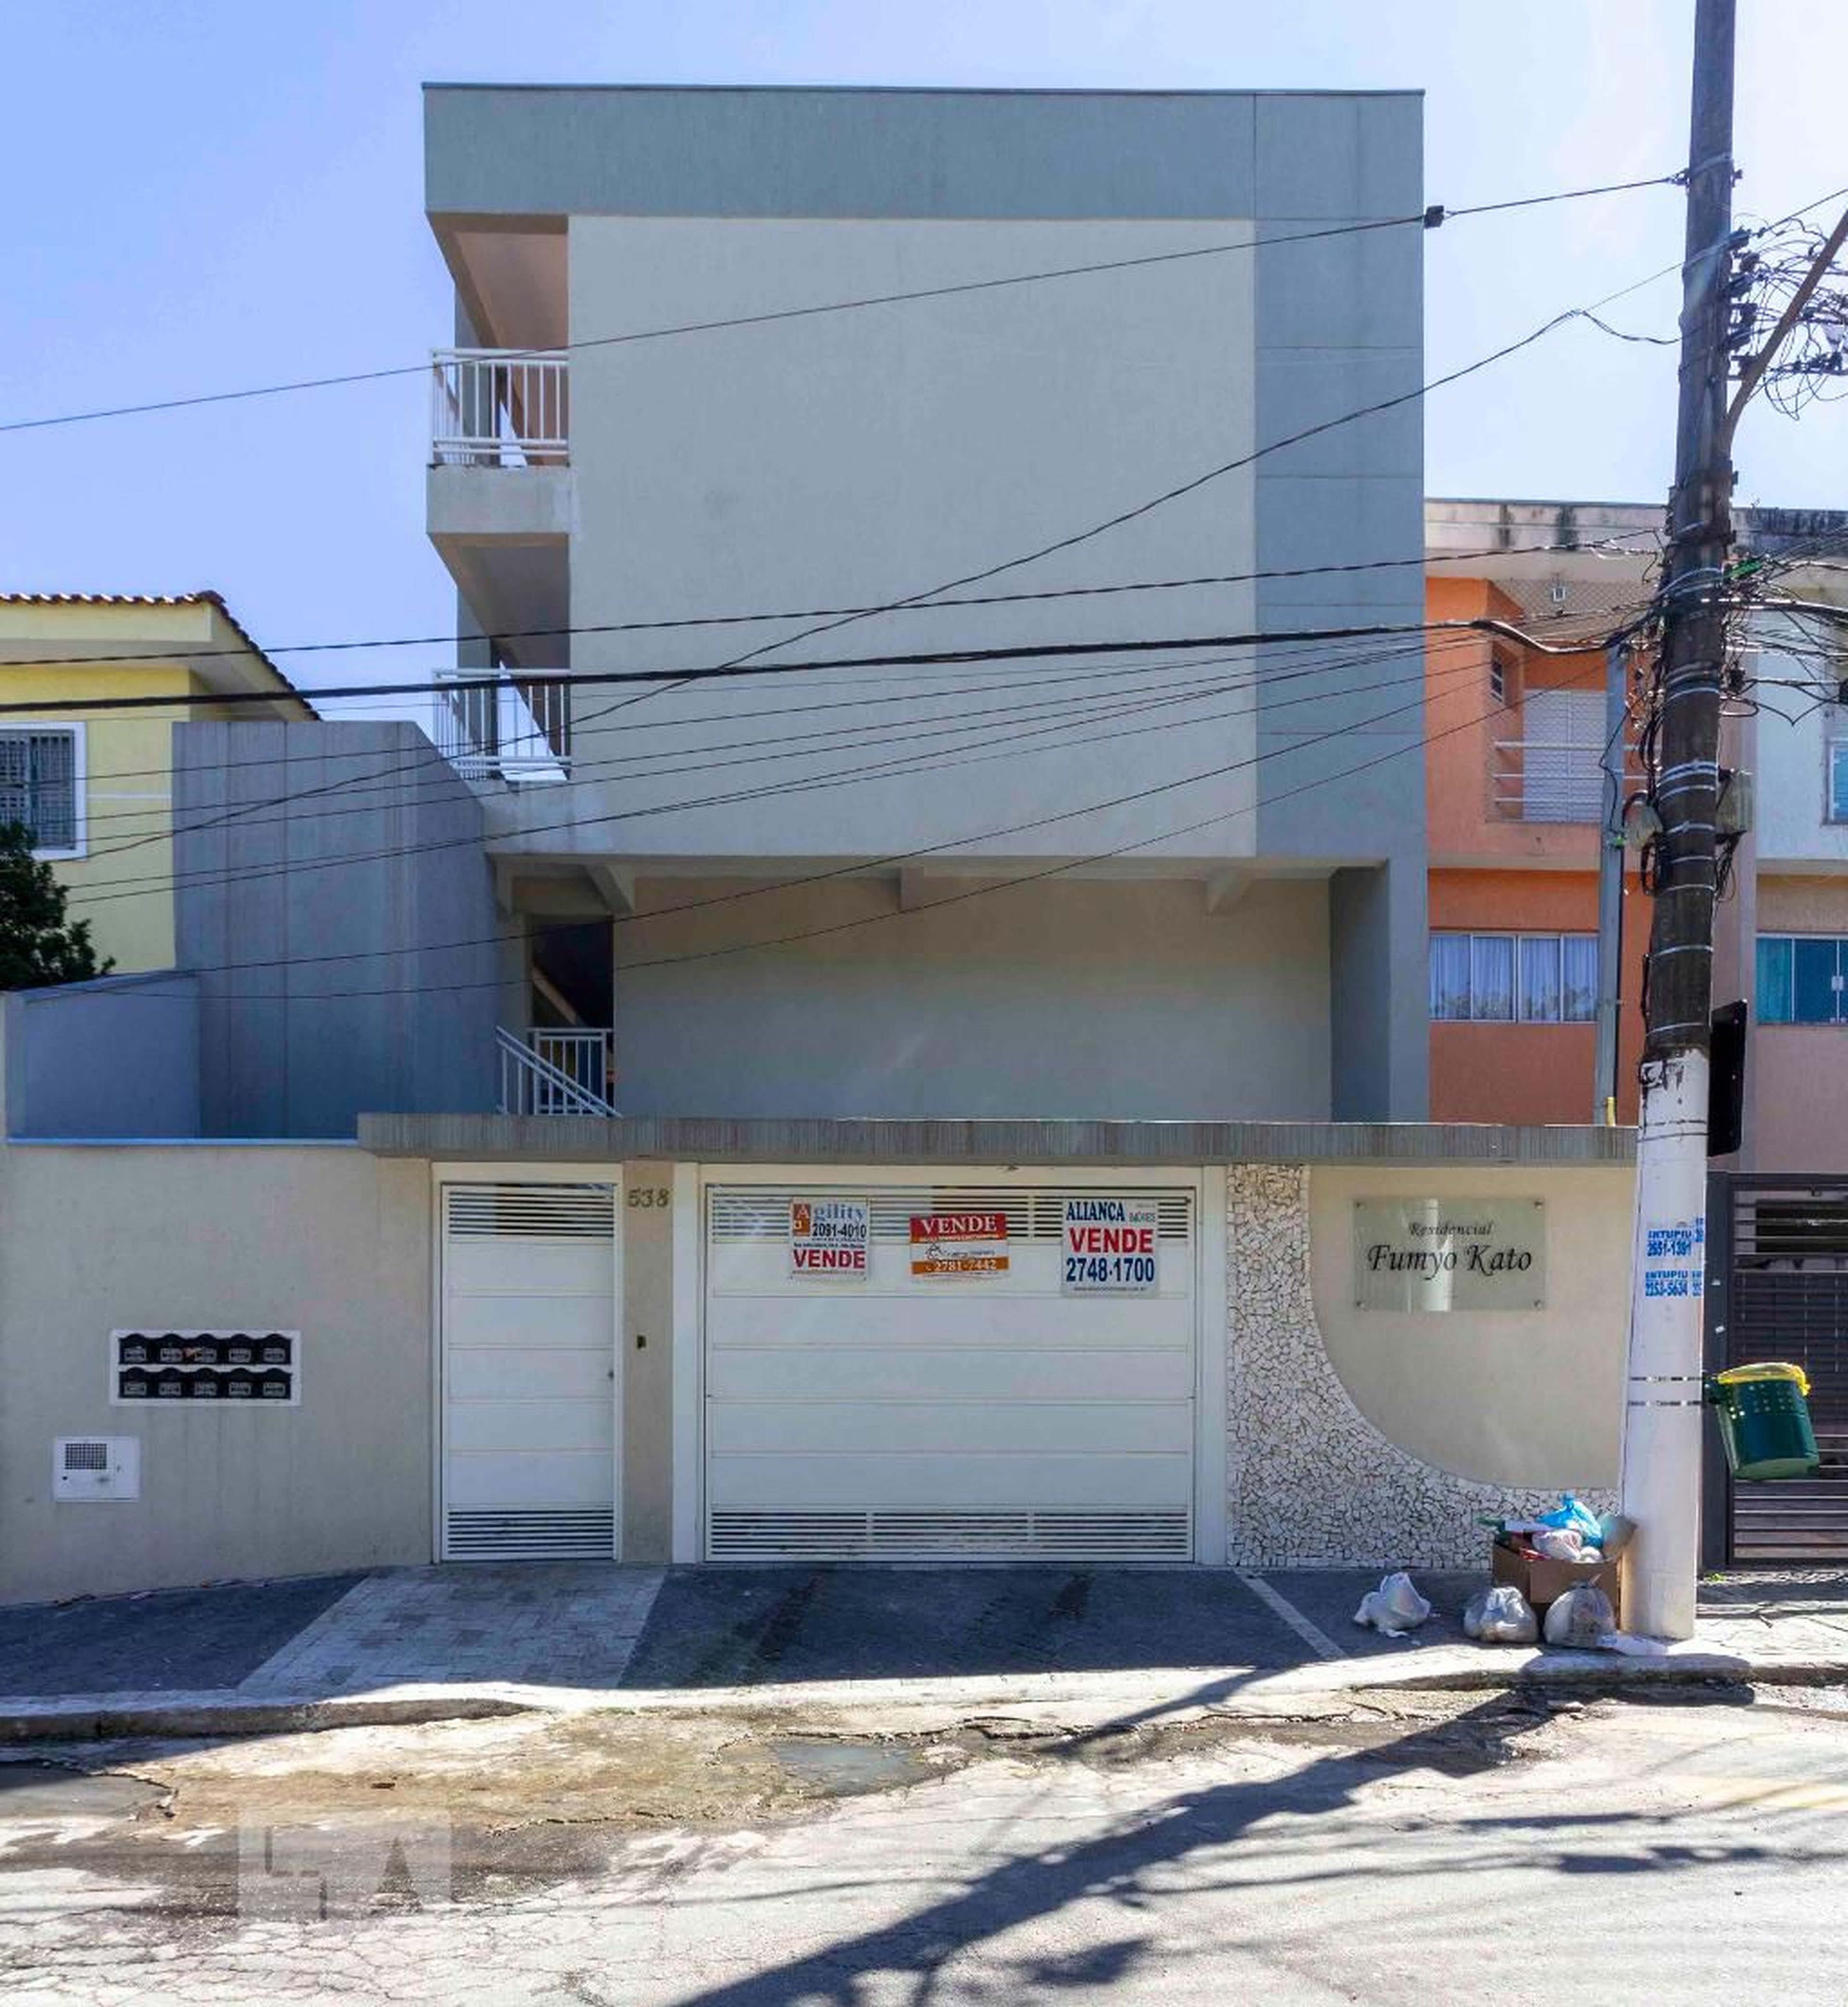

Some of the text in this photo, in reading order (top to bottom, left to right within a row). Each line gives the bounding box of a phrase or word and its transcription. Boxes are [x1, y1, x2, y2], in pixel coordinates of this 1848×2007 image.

[921, 1215, 997, 1234] VENDE
[1410, 1221, 1493, 1236] Residencial
[1069, 1227, 1154, 1253] VENDE
[794, 1249, 865, 1268] VENDE
[1368, 1244, 1532, 1281] Fumyo Kato
